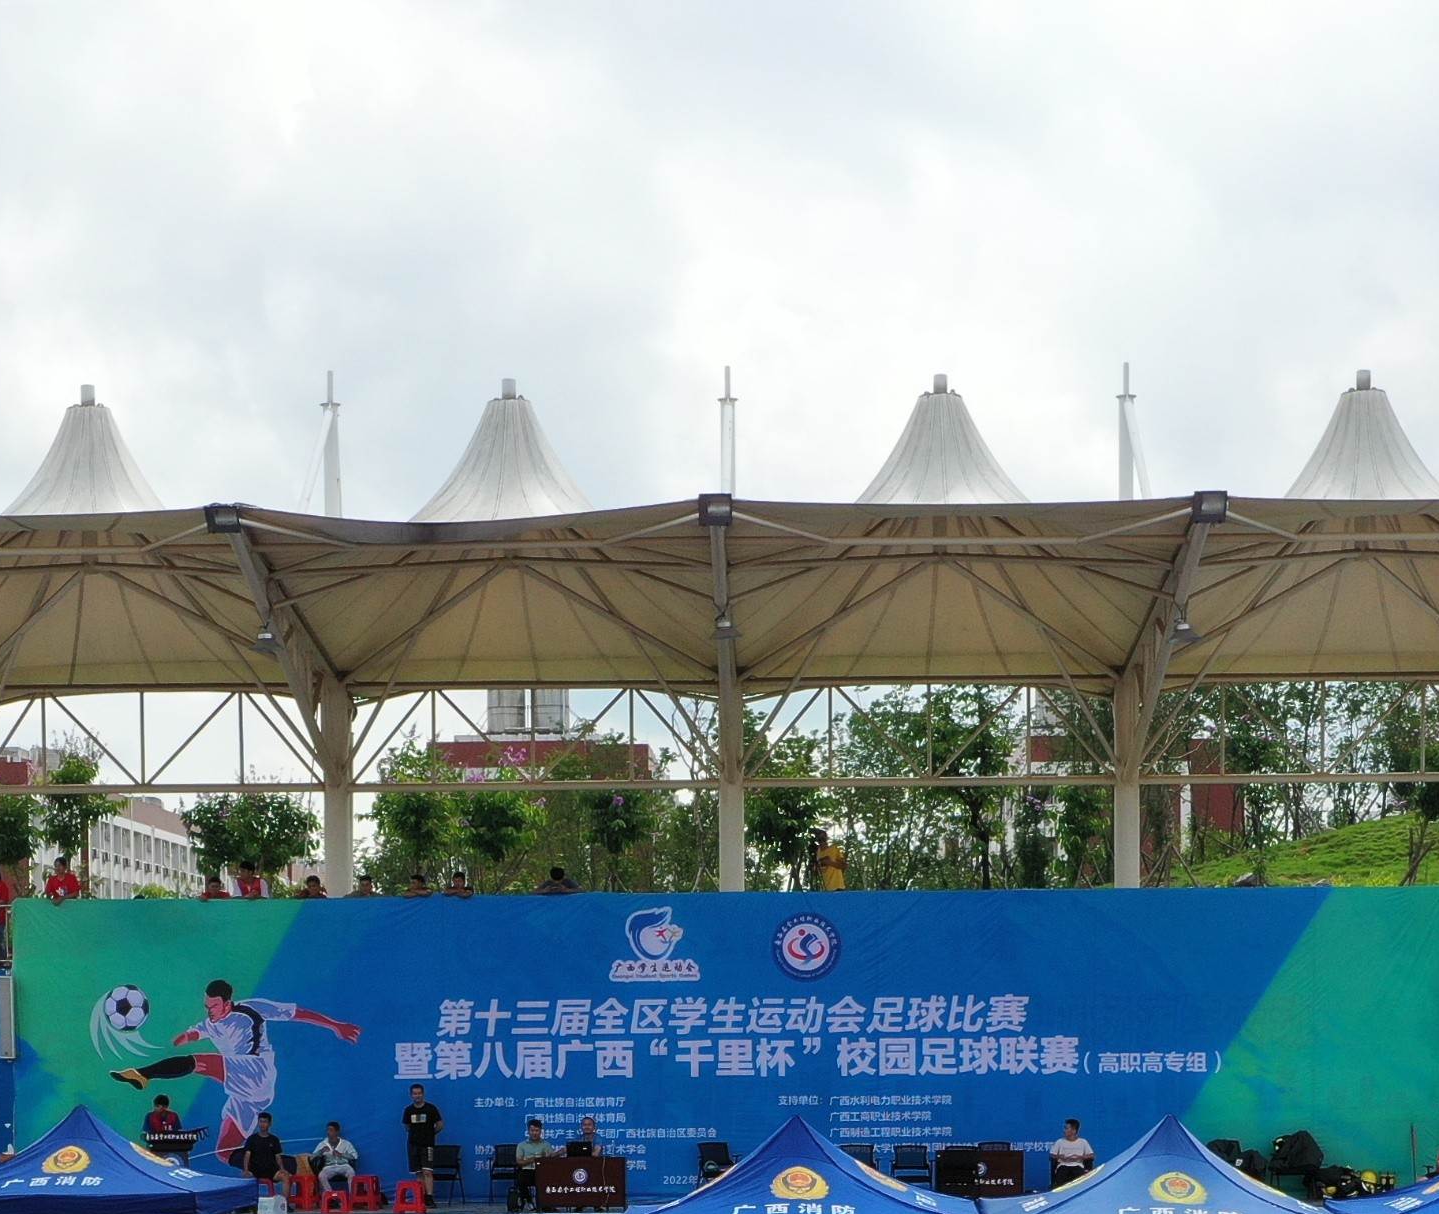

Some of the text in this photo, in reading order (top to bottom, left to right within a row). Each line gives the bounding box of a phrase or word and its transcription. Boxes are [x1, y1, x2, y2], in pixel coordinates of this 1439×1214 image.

[436, 994, 1030, 1038] 第十三届全区学生运动会足球比赛
[1, 1176, 104, 1189] 广西消防
